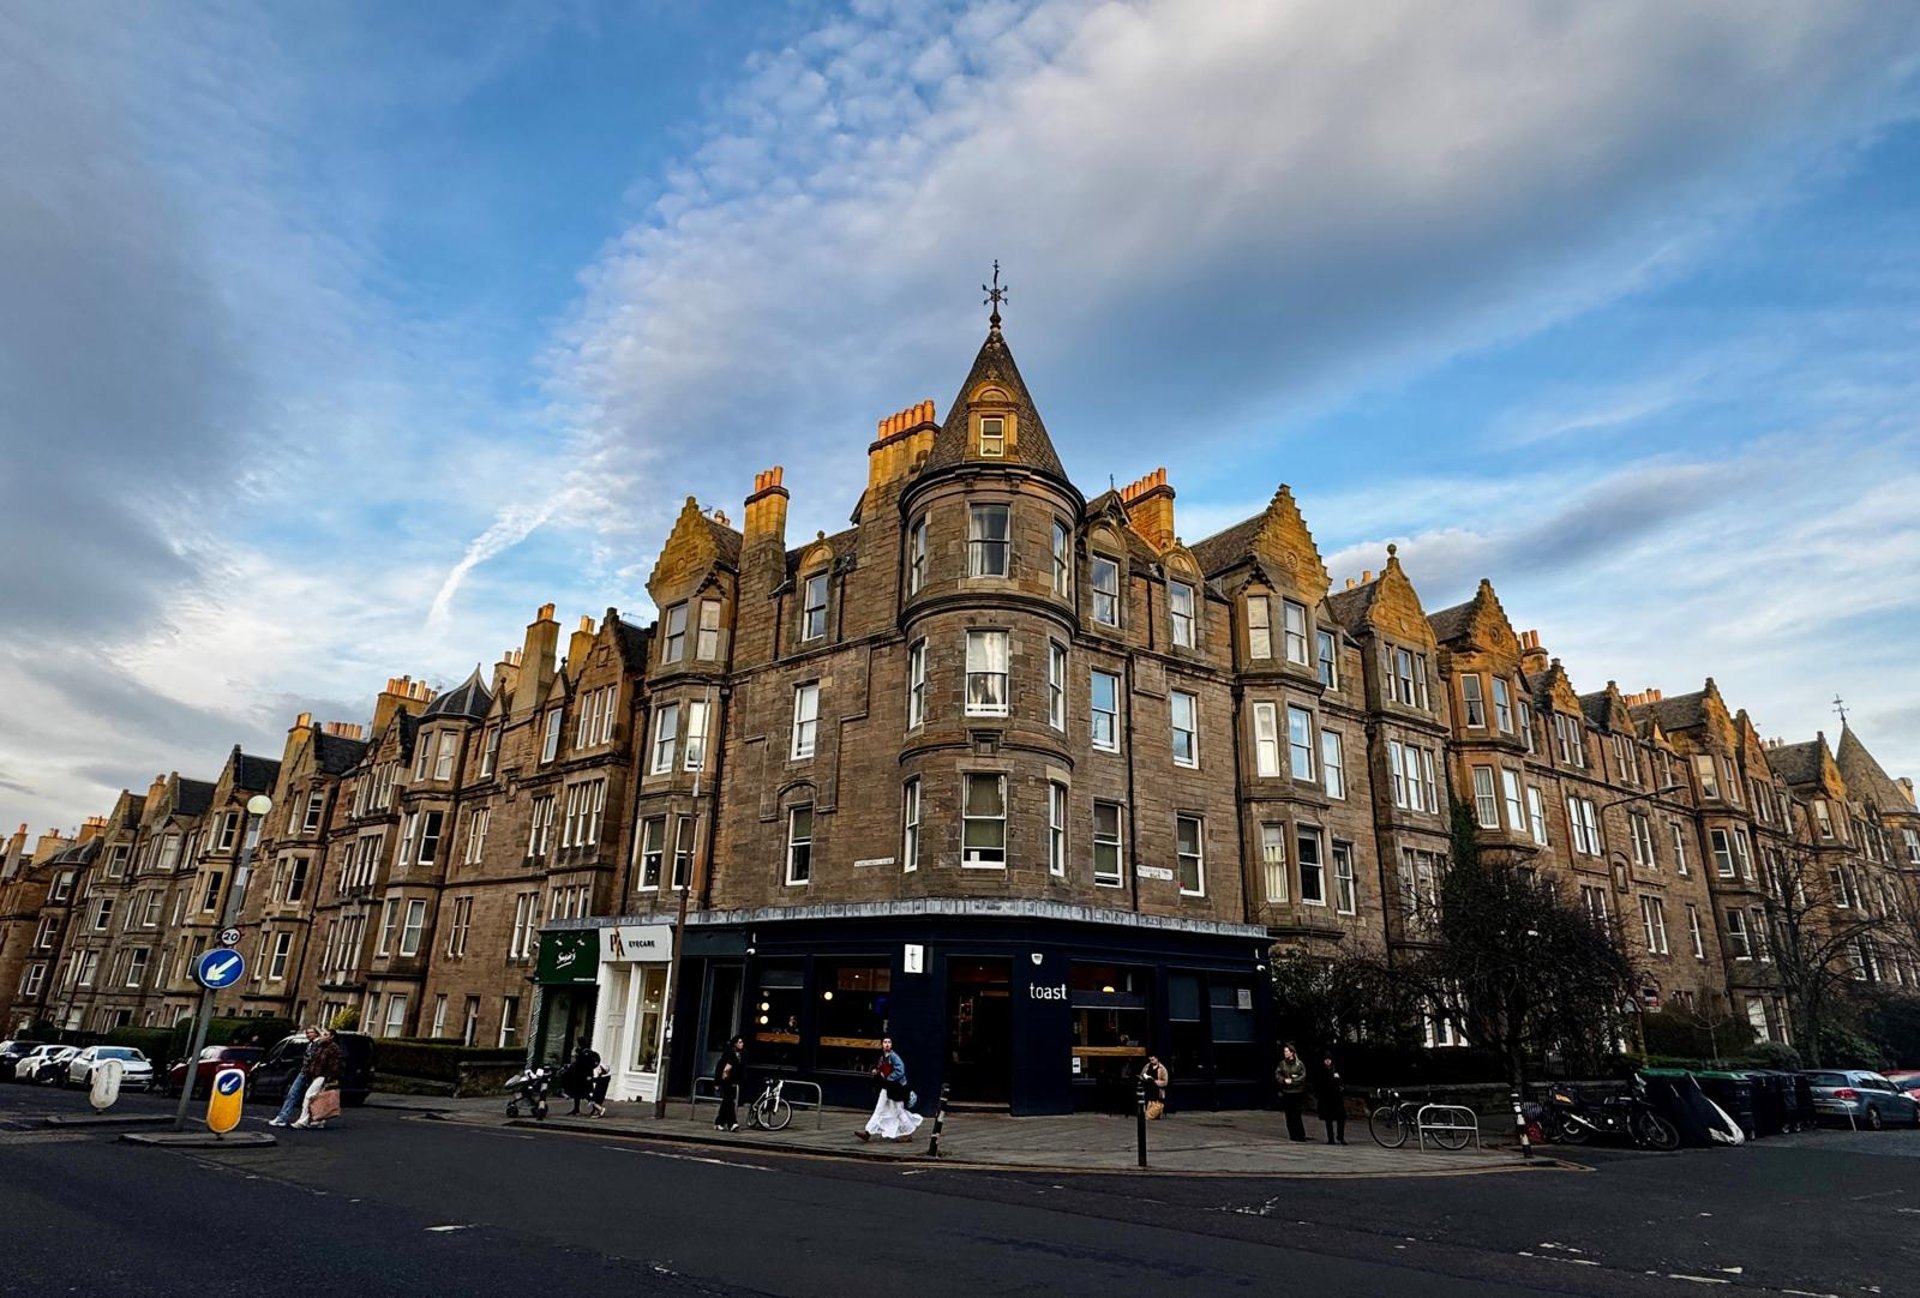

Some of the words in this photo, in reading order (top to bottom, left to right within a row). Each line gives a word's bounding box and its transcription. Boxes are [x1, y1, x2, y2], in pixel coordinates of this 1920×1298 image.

[223, 932, 239, 941] 20
[628, 940, 655, 948] EYECARE
[909, 947, 917, 970] t
[1029, 982, 1067, 1000] toast
